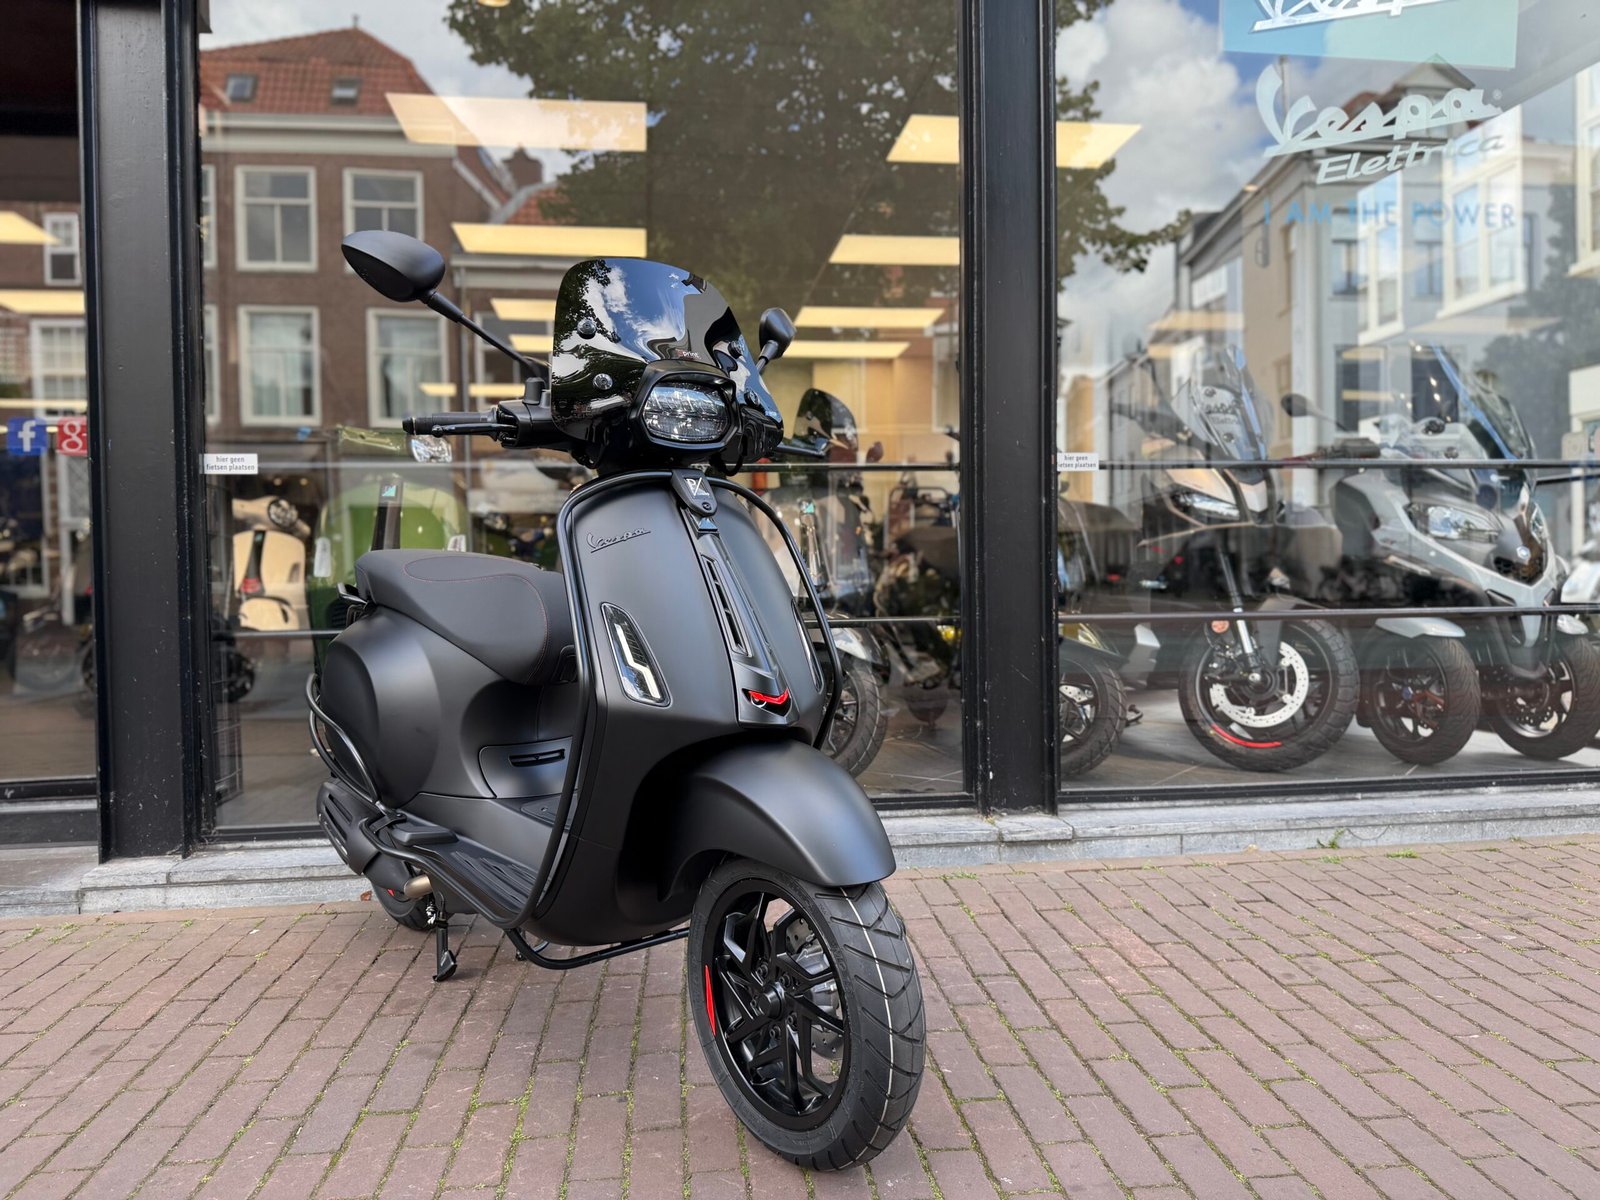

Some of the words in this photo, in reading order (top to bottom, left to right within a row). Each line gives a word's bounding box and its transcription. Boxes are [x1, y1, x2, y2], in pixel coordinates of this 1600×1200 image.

[1255, 63, 1503, 158] Vespa
[1284, 200, 1333, 226] AM
[1346, 200, 1397, 227] THE
[1411, 200, 1516, 228] POWER
[229, 456, 245, 464] geen
[206, 463, 228, 471] fietsen
[228, 463, 255, 472] plaatsen
[1075, 461, 1096, 469] plaatsen
